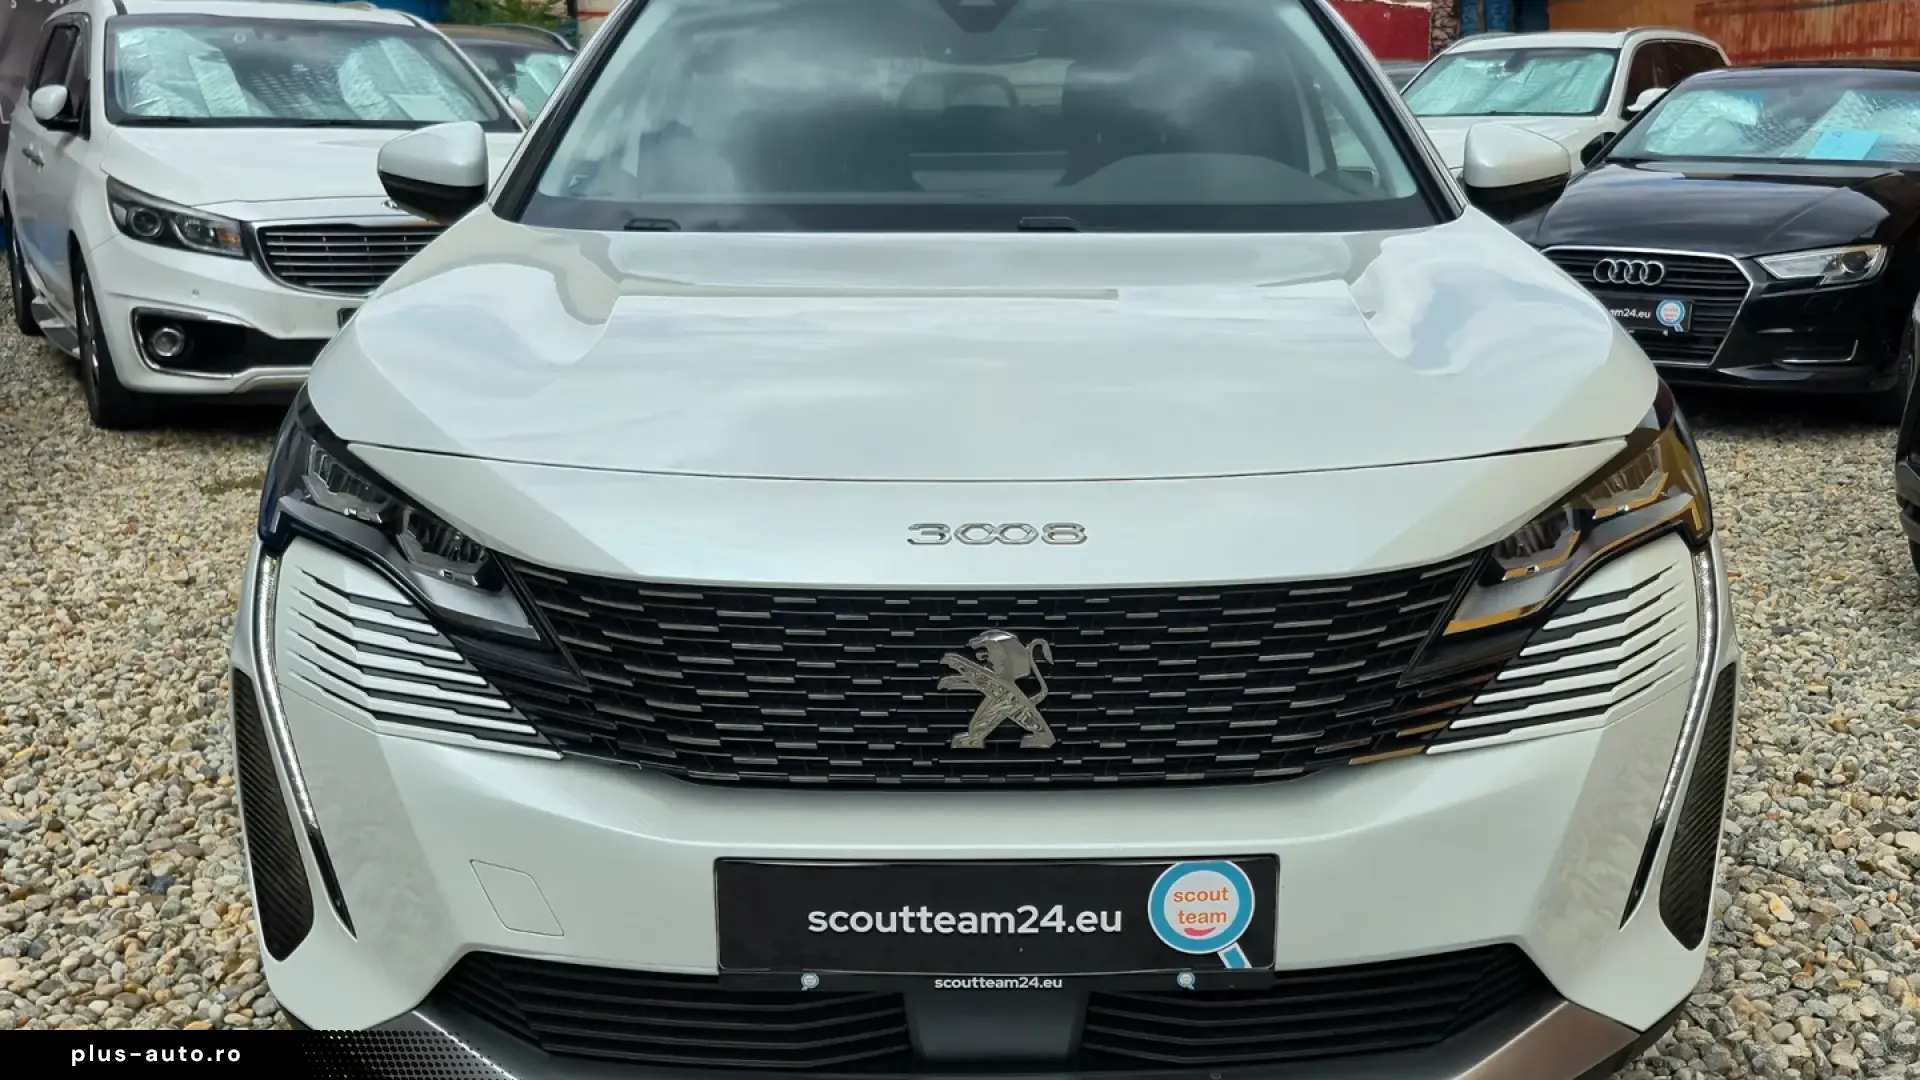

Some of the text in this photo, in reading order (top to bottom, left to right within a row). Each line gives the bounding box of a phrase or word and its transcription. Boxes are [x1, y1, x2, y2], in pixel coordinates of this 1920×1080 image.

[907, 522, 1088, 545] 3008
[1173, 887, 1229, 902] scout
[807, 904, 1122, 934] scoutteam24.eu
[1178, 910, 1228, 924] team
[934, 976, 1063, 989] scoutteam24.eu
